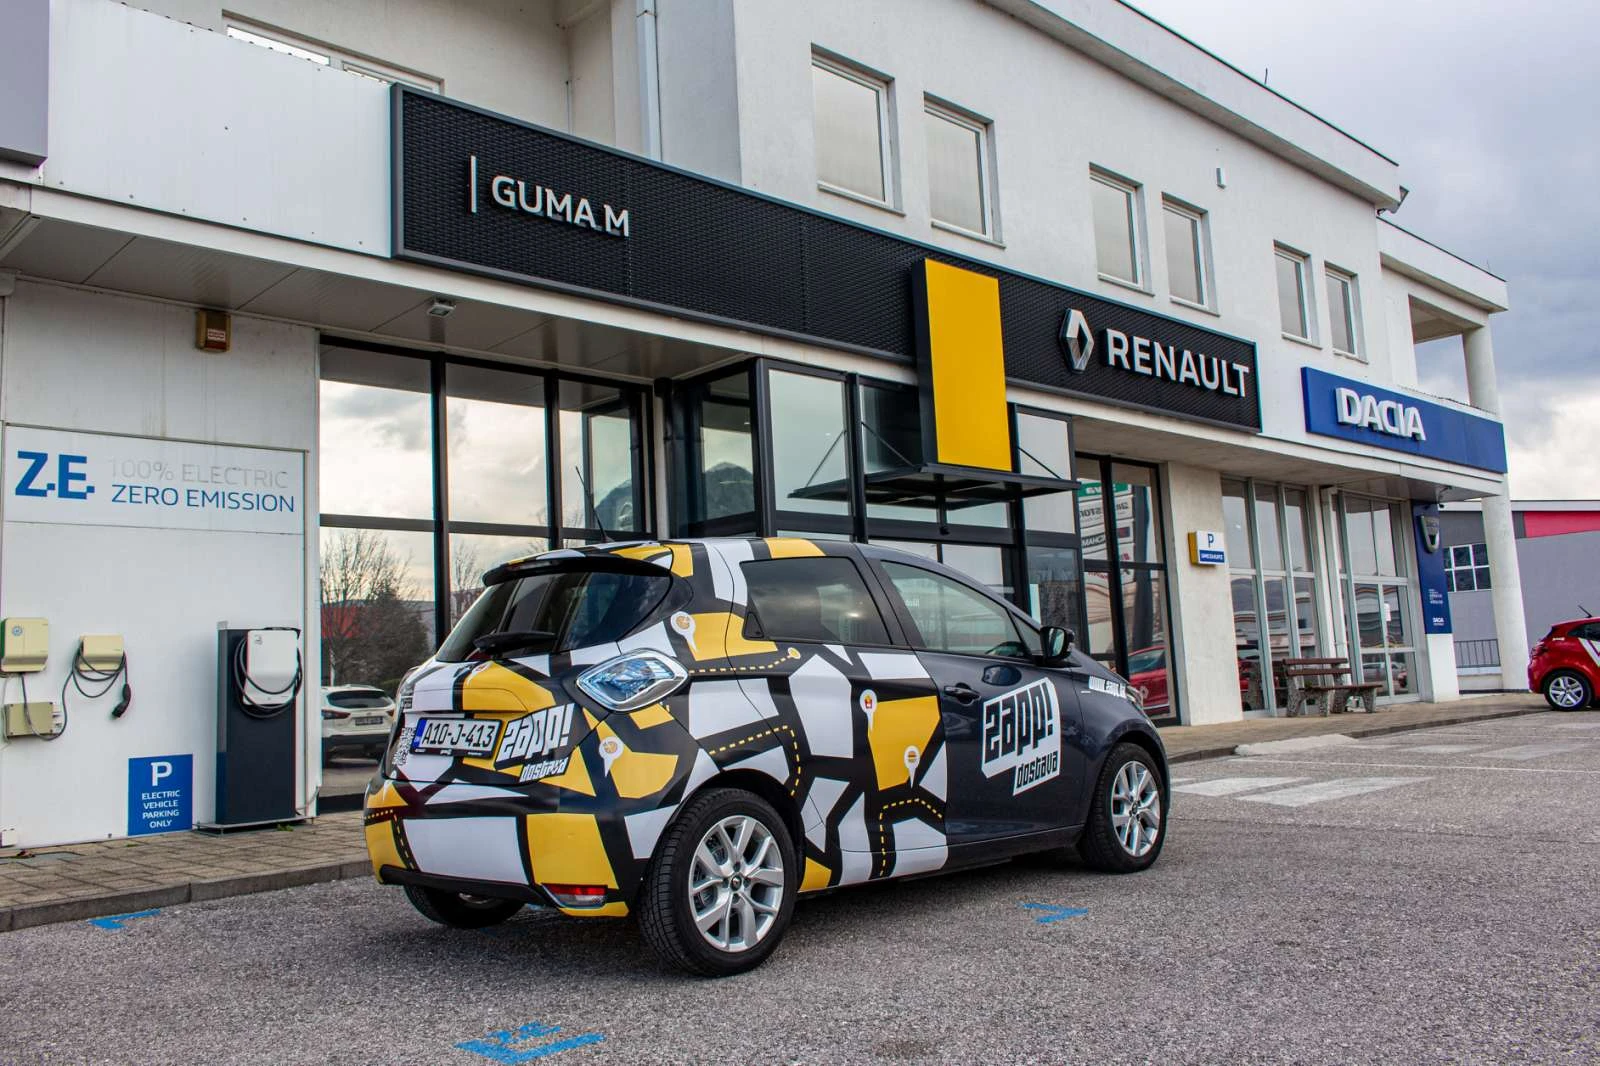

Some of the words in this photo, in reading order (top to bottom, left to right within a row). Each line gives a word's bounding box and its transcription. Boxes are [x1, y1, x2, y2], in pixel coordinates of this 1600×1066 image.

[491, 175, 597, 229] GUMA
[603, 203, 630, 237] M
[1106, 328, 1250, 398] RENAULT
[1335, 387, 1427, 441] DACIA
[14, 450, 95, 500] Z.E.
[108, 458, 175, 482] 100%
[181, 463, 289, 489] ELECTRIC
[111, 484, 179, 506] ZERO
[186, 489, 295, 513] EMISSION
[1207, 533, 1215, 548] P
[421, 722, 496, 748] A10-J-413
[150, 761, 173, 787] P
[1016, 750, 1059, 789] dostava
[141, 789, 181, 801] ELECTRIC
[143, 799, 179, 810] VEHICLE
[142, 809, 180, 820] PARKING
[149, 819, 172, 829] ONLY
